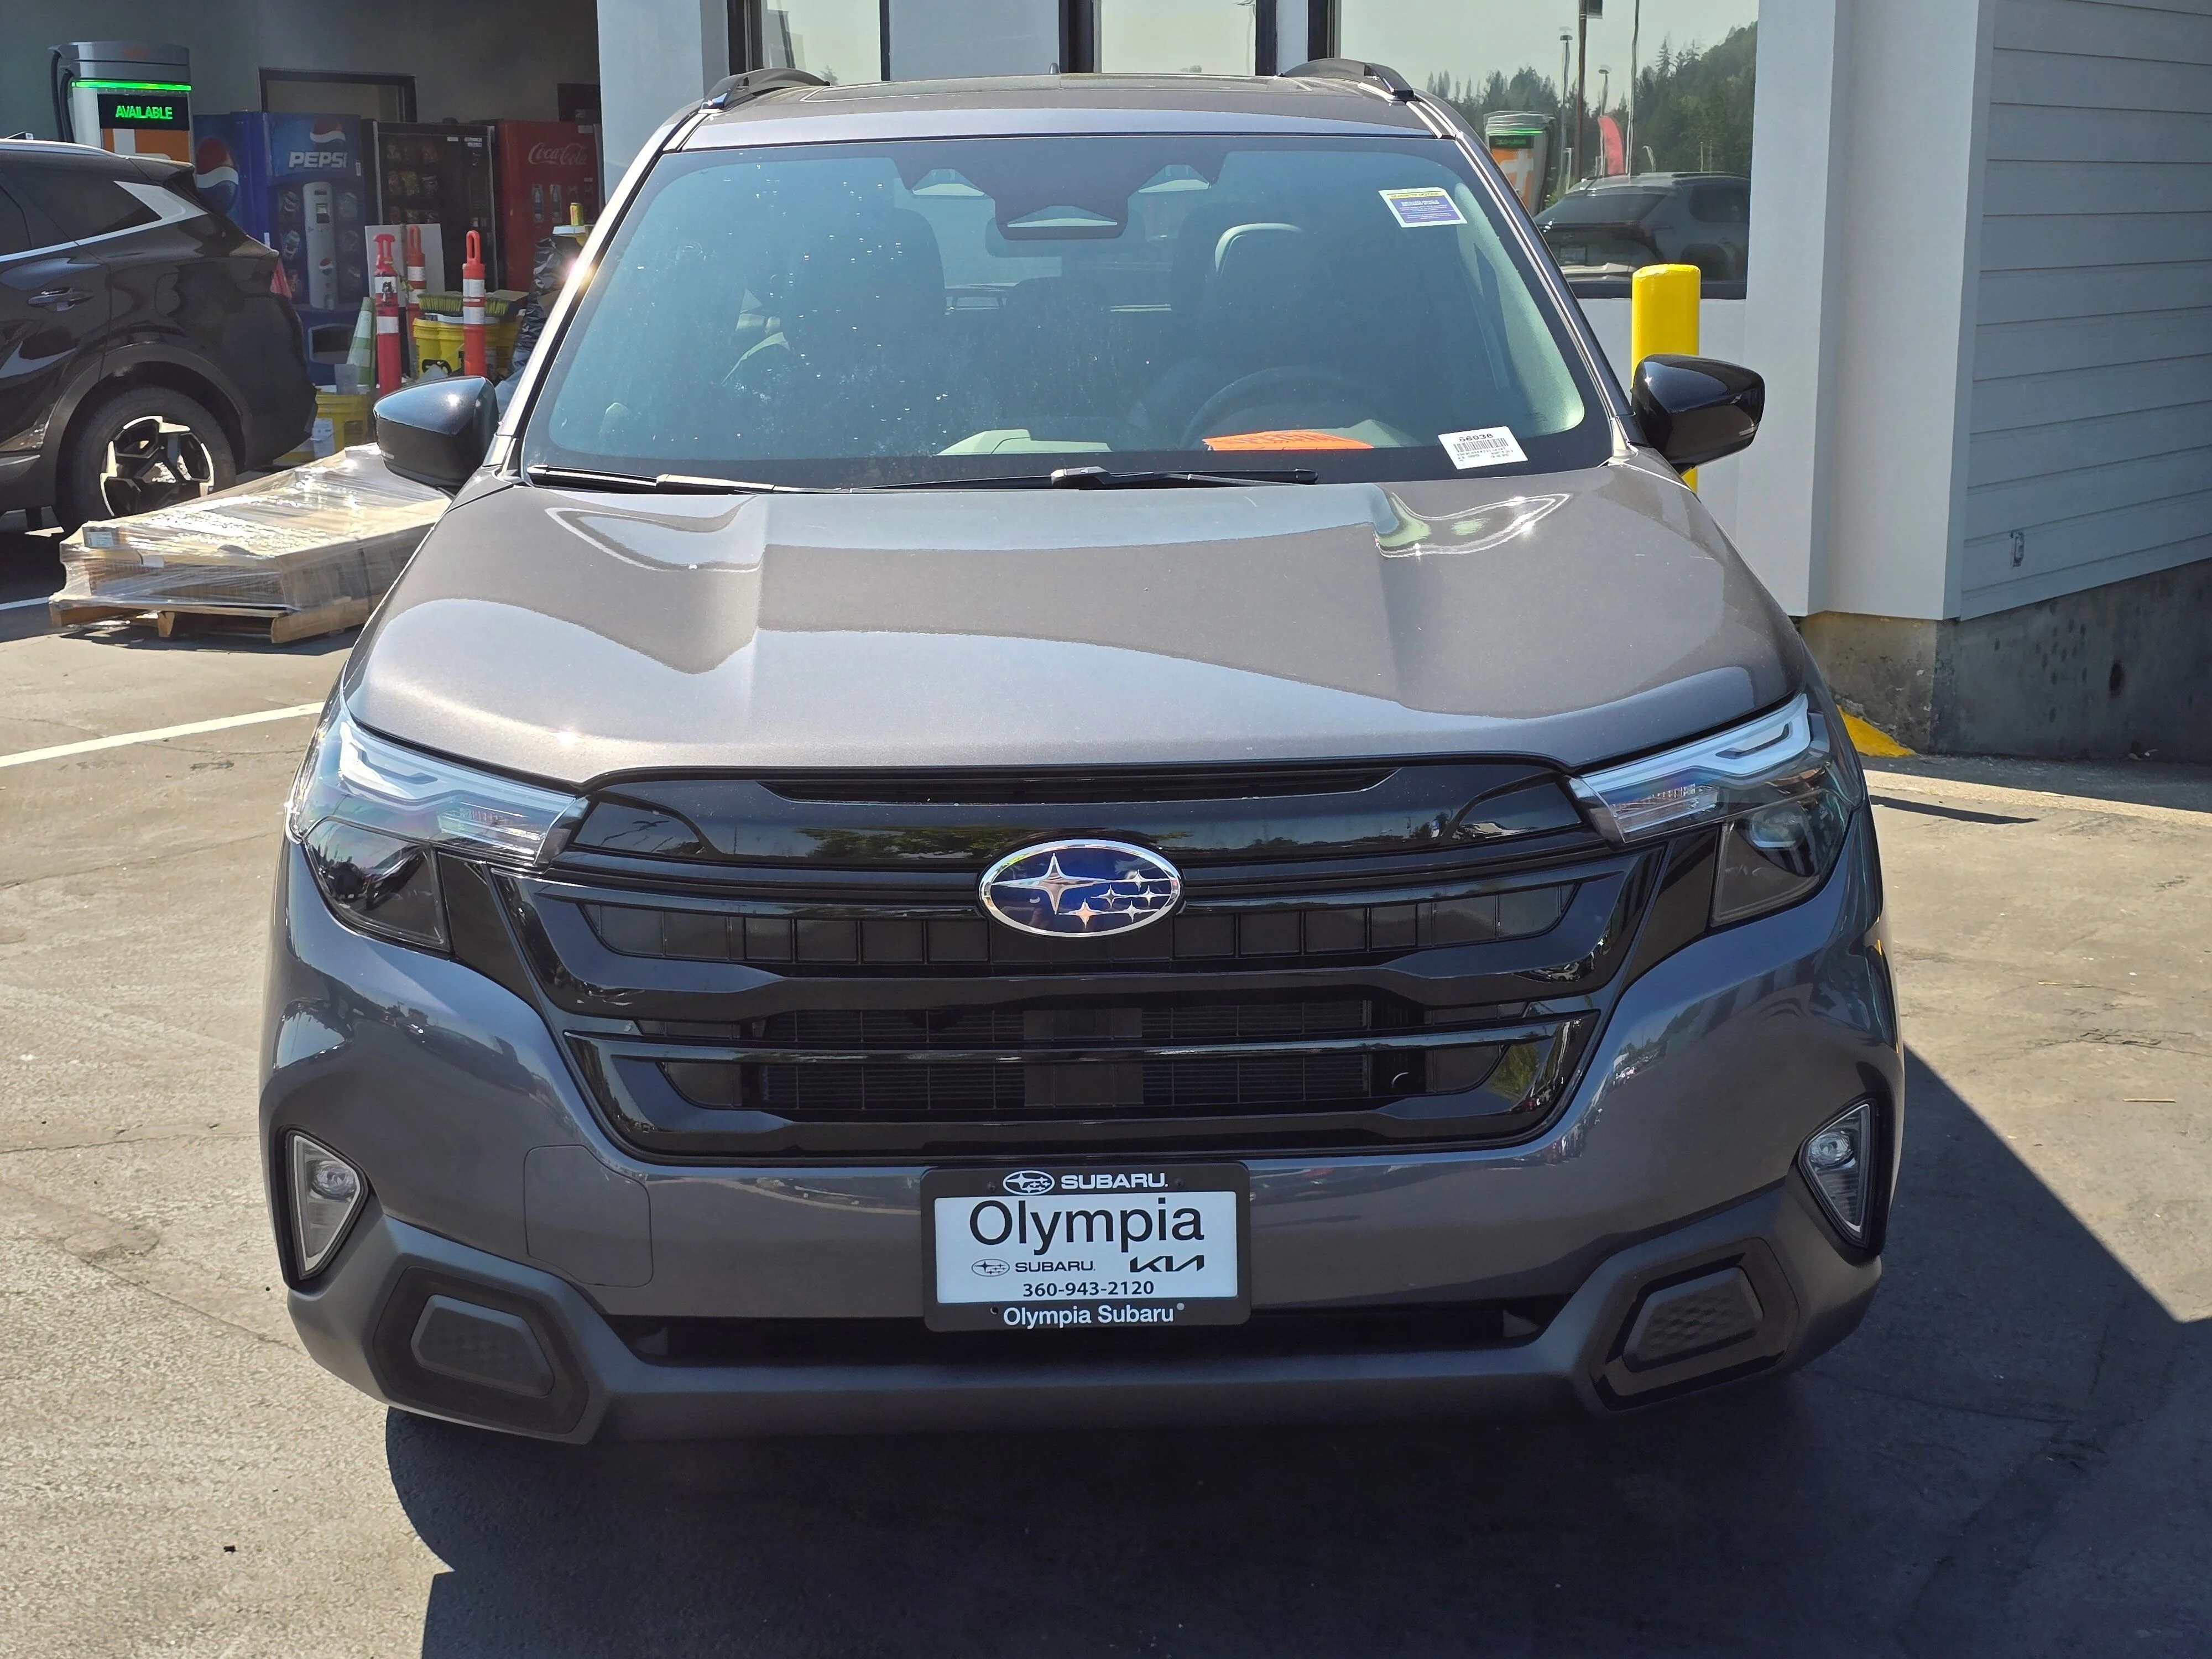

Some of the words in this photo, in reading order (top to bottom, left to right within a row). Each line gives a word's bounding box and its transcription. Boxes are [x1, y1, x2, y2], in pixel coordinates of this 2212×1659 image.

[116, 105, 173, 119] AVAILABLE
[289, 152, 348, 168] PEPSI
[970, 1197, 1204, 1255] Olympia
[1023, 1281, 1154, 1297] 360-943-2120
[1003, 1306, 1092, 1329] Olympia
[1098, 1305, 1173, 1323] Subaru
